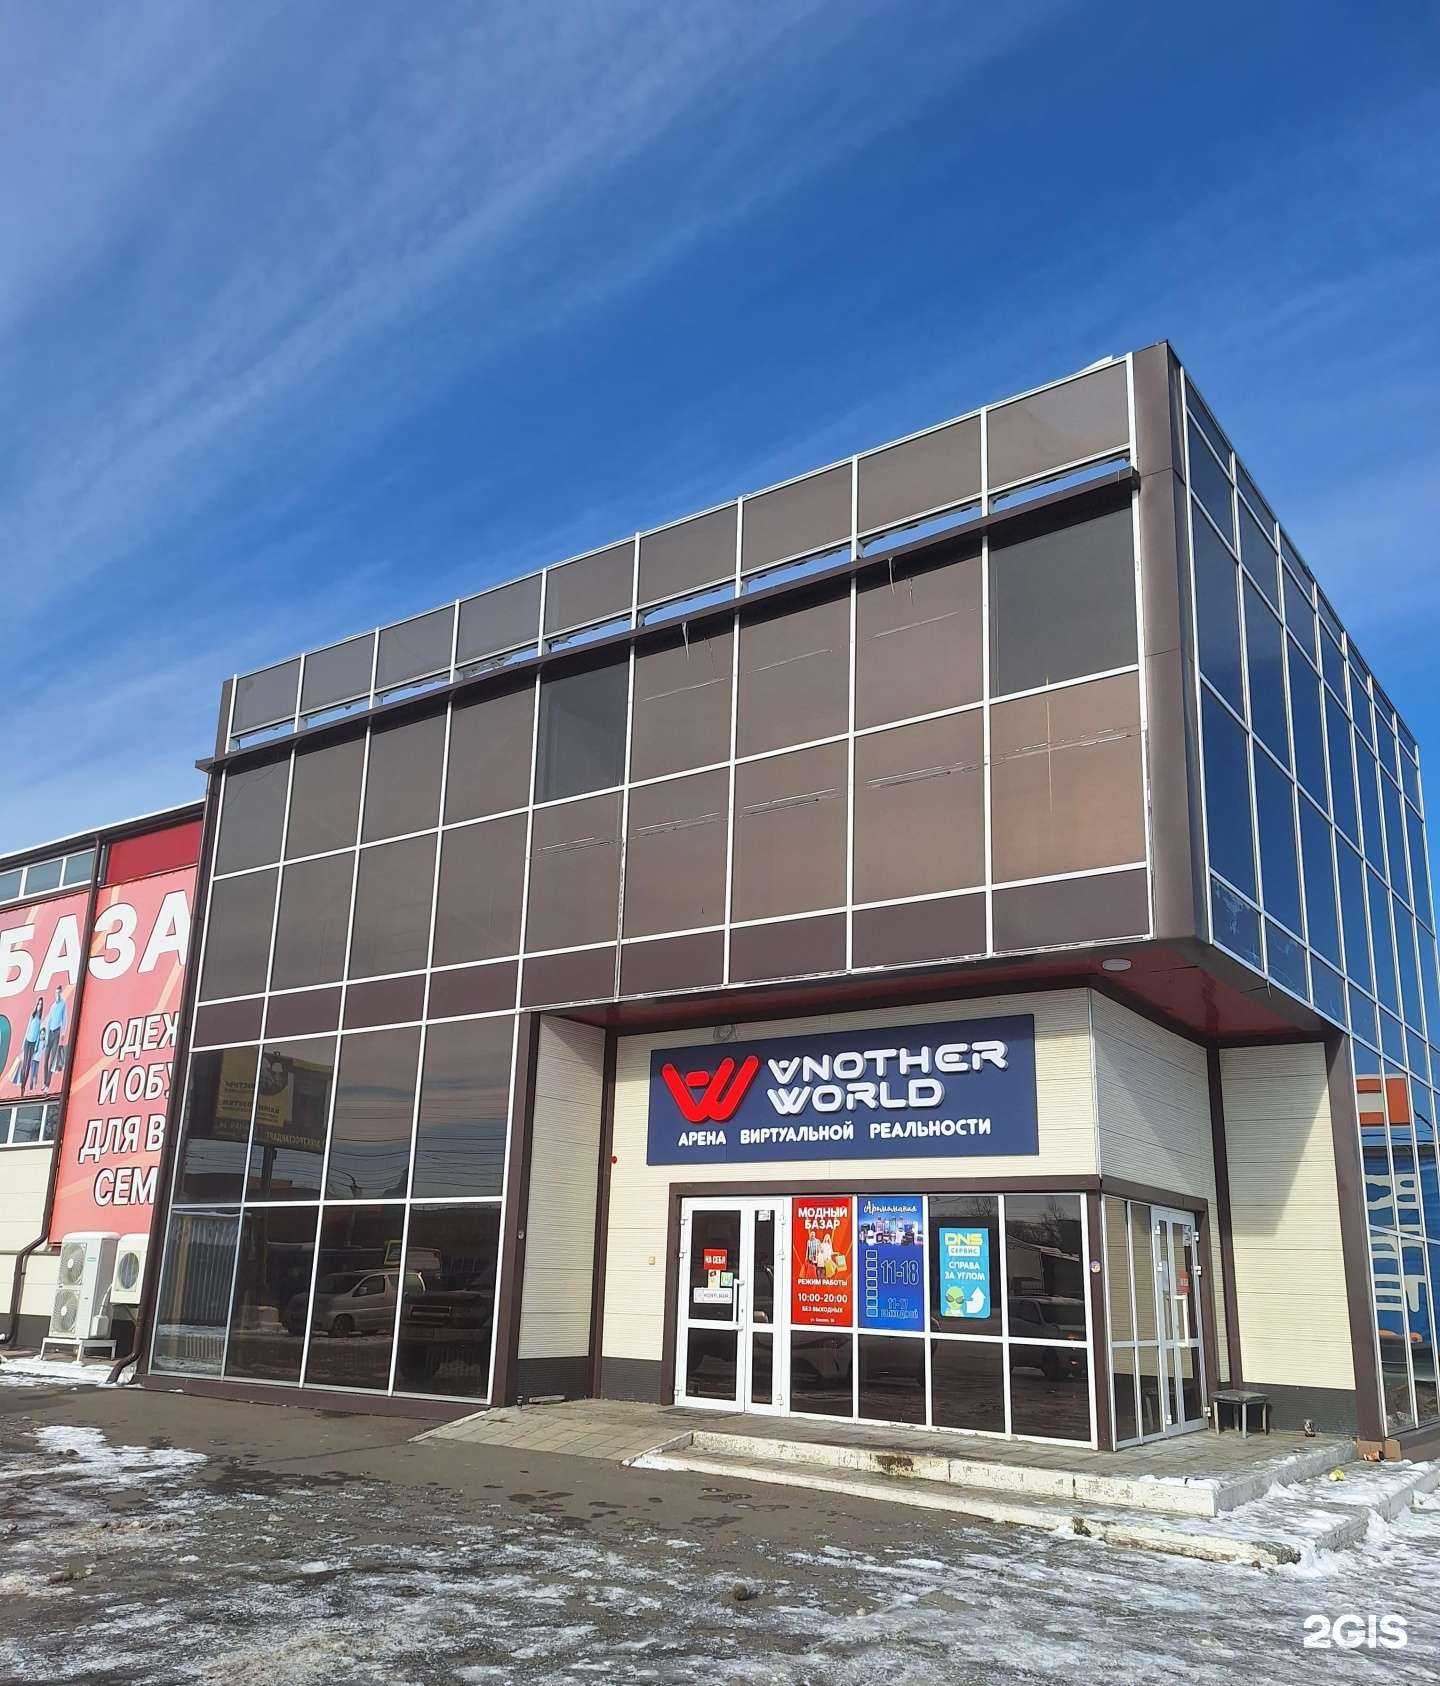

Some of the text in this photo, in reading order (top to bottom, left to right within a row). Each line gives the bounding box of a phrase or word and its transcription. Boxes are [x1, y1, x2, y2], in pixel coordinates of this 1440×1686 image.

[98, 1068, 121, 1105] И
[766, 1078, 945, 1116] WORLD
[78, 1115, 142, 1164] ДЛЯ
[678, 1118, 992, 1147] АРЕНА ВИРТУАЛЬНОЙ РЕАЛЬНОСТИ
[798, 1206, 848, 1220] МОДНЫЙ
[804, 1219, 841, 1230] БАЗАР
[944, 1232, 983, 1246] DNS
[880, 1259, 920, 1285] 11-18
[948, 1261, 980, 1270] СПРАВА
[797, 1278, 848, 1287] РЕЖИМ РАБОТЫ
[957, 1271, 986, 1281] УГЛОМ
[797, 1292, 848, 1303] 10:00-20:00
